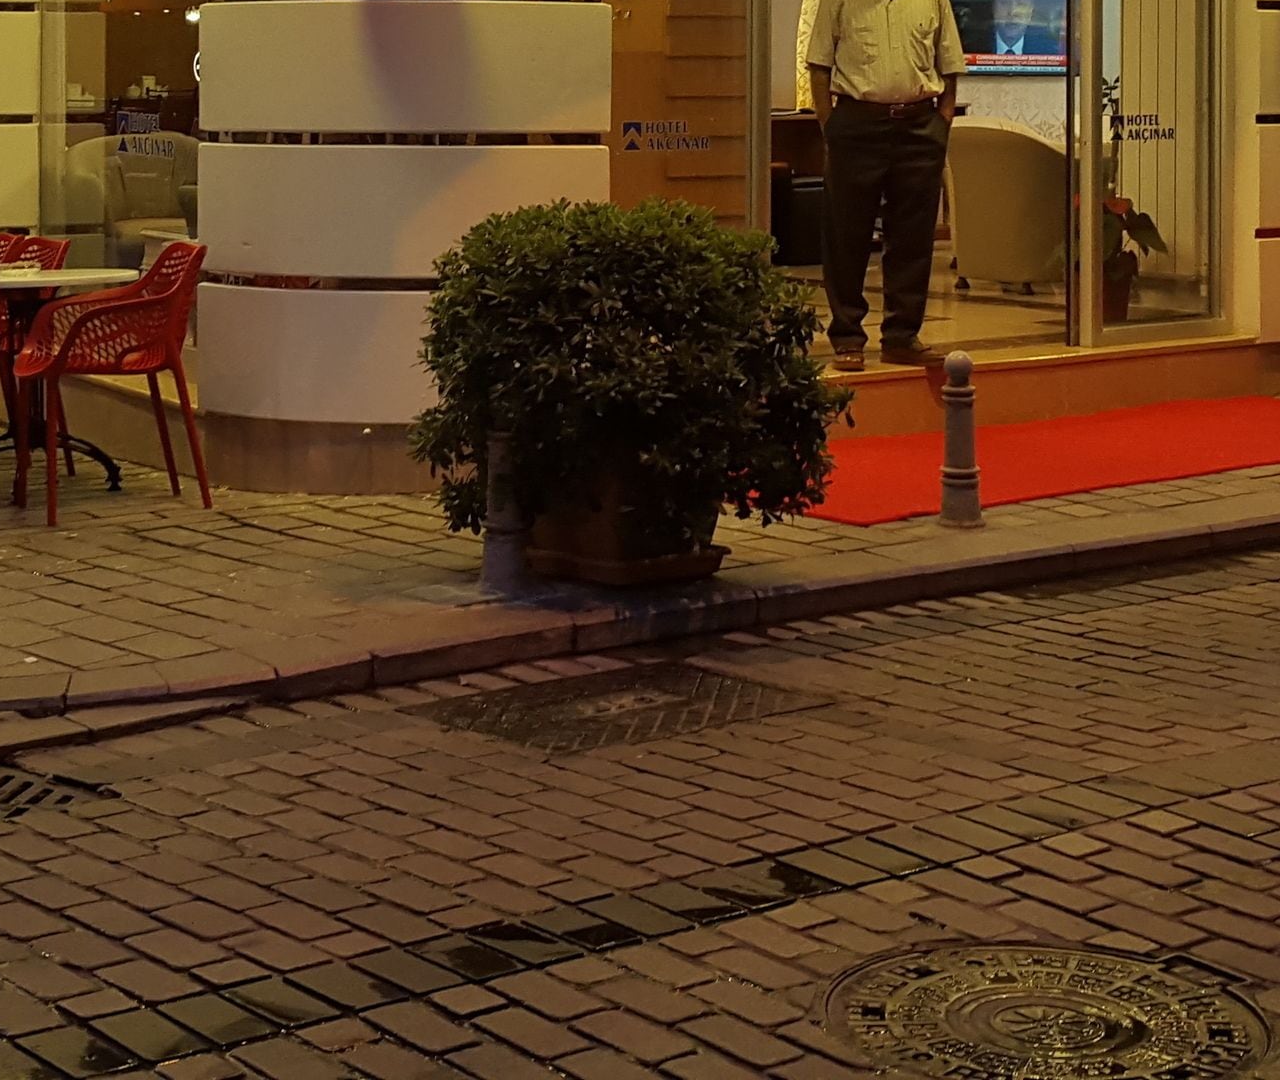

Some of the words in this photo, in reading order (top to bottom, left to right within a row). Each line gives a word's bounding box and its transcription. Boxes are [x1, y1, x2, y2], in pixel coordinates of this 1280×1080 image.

[1127, 114, 1160, 126] HOTEL
[646, 121, 688, 134] HOTEL
[1127, 128, 1175, 144] AKÇINAR
